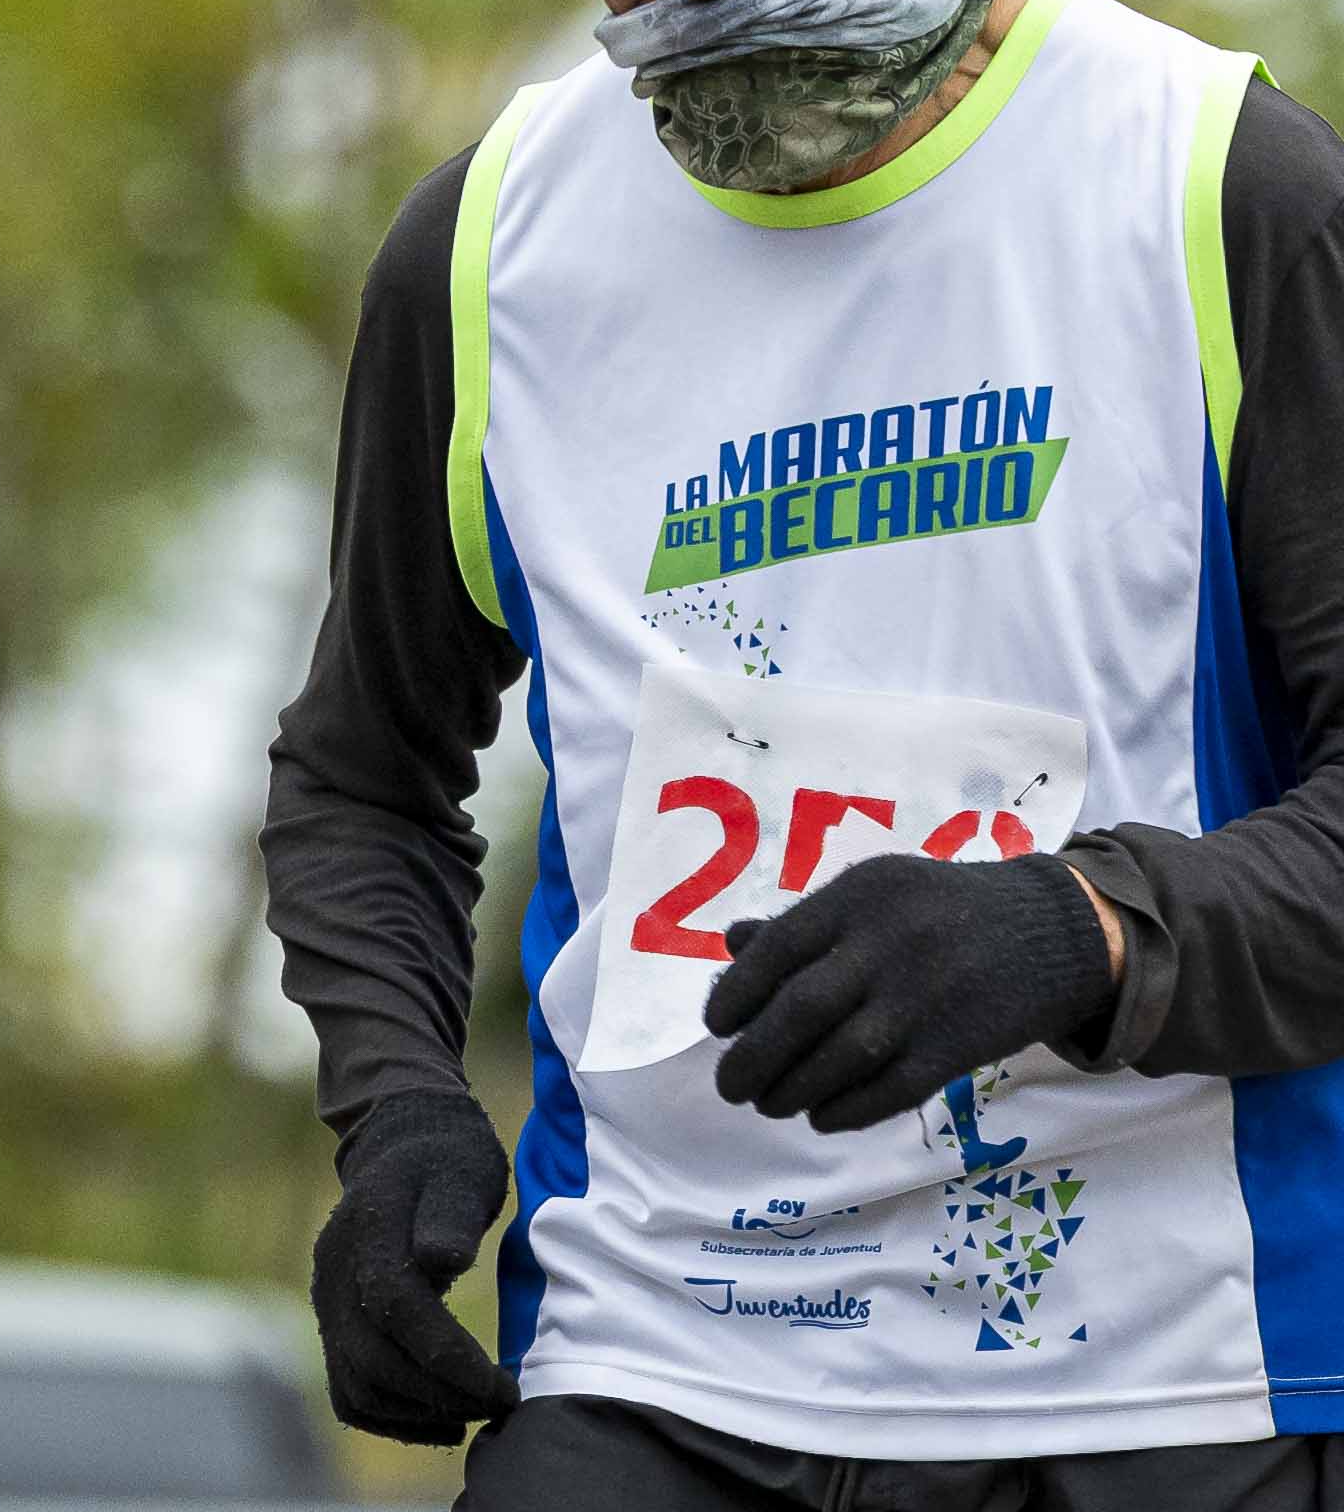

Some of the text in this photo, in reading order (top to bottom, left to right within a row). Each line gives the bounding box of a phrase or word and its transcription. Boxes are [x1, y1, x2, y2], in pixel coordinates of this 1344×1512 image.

[665, 380, 1053, 515] LA MARATÓN
[664, 451, 1034, 574] DEL BECARIO
[767, 1198, 805, 1217] soy
[700, 1240, 882, 1256] Subsecretaría de Juventud
[683, 1277, 872, 1320] Juventudes
